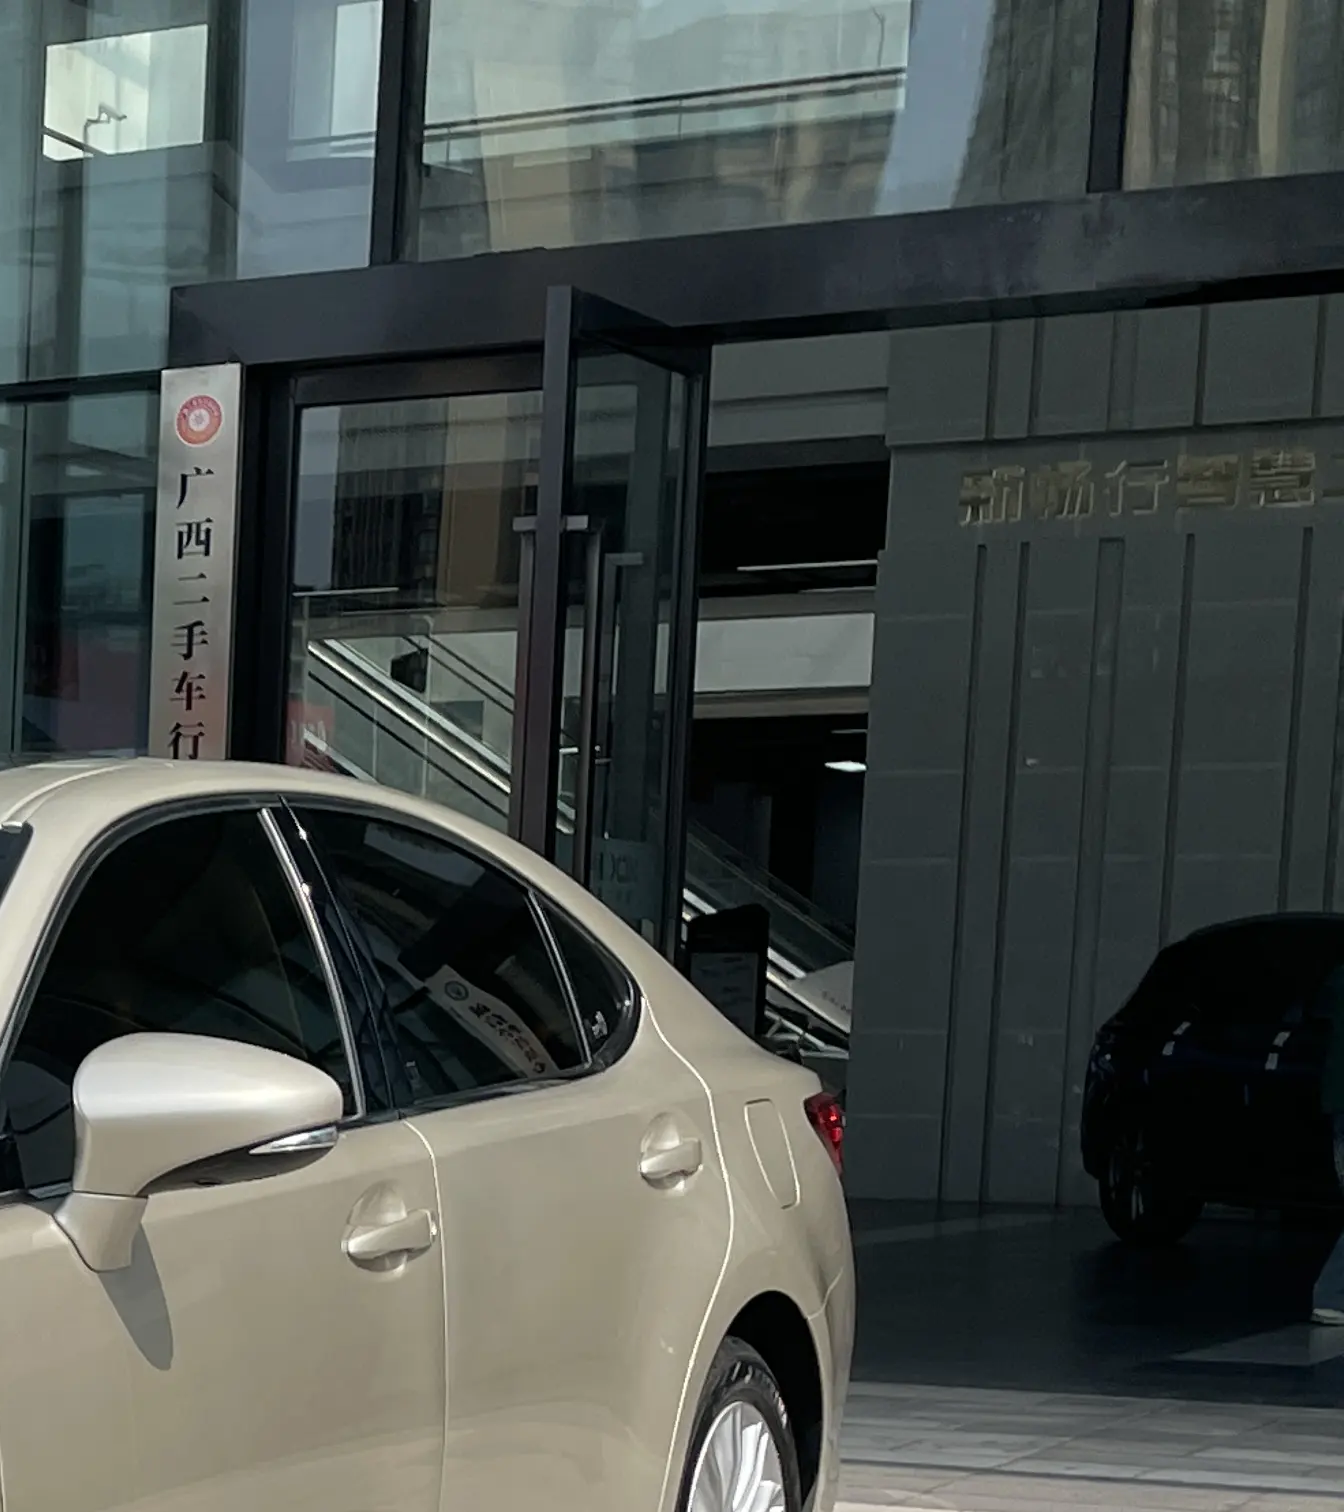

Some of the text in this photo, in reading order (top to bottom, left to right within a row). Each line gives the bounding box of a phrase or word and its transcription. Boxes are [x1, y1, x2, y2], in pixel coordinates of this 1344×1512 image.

[167, 466, 215, 761] 广西二手车行
